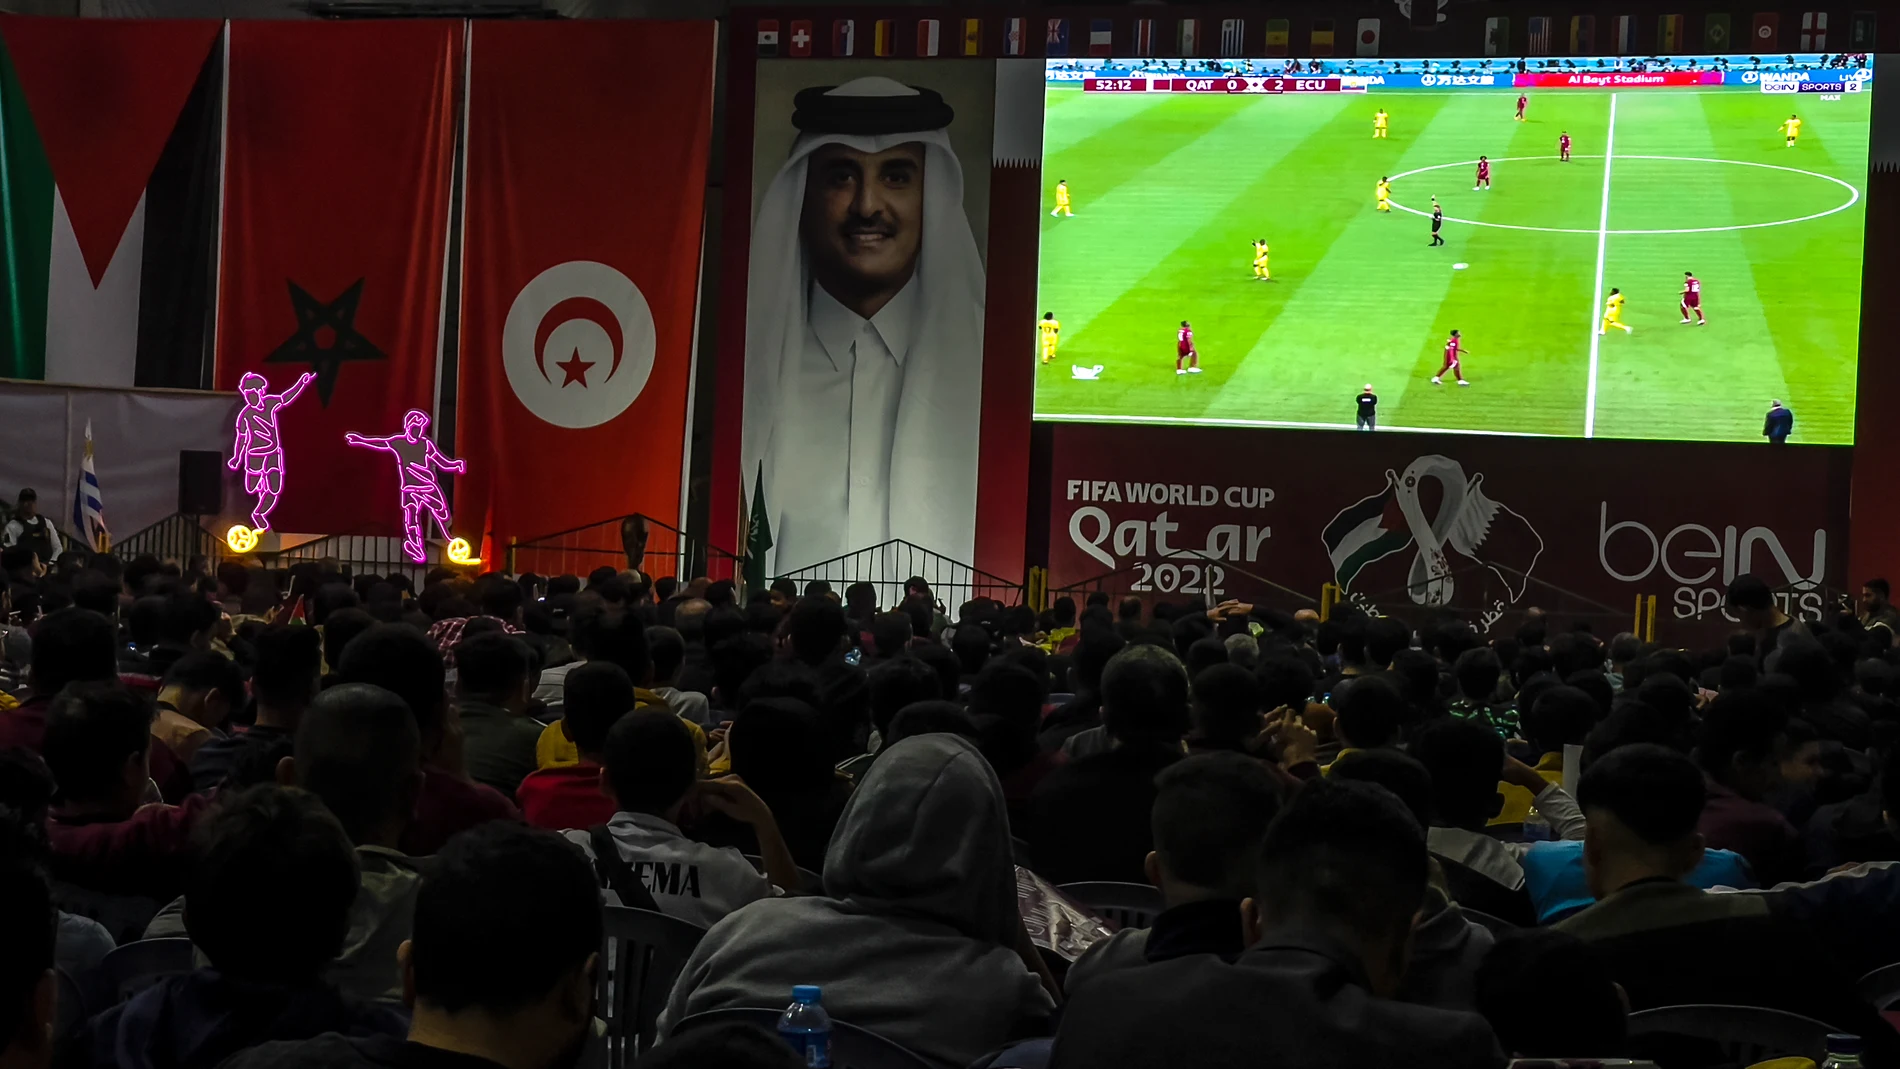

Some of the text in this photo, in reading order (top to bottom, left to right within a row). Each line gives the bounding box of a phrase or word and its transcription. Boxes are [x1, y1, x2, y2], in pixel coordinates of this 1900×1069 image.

[1568, 74, 1664, 86] Al Bayt Stadium
[1759, 72, 1810, 82] WANDA
[1096, 79, 1132, 91] 52:12
[1185, 79, 1238, 91] QAT 0
[1274, 79, 1326, 91] 2 ECU
[1801, 83, 1842, 91] SPORTS
[1849, 83, 1857, 91] 2
[1066, 479, 1275, 508] FIFA WORLD CUP
[1068, 505, 1272, 570] Qatar
[1130, 562, 1225, 596] 2022
[1673, 586, 1823, 623] SPTS
